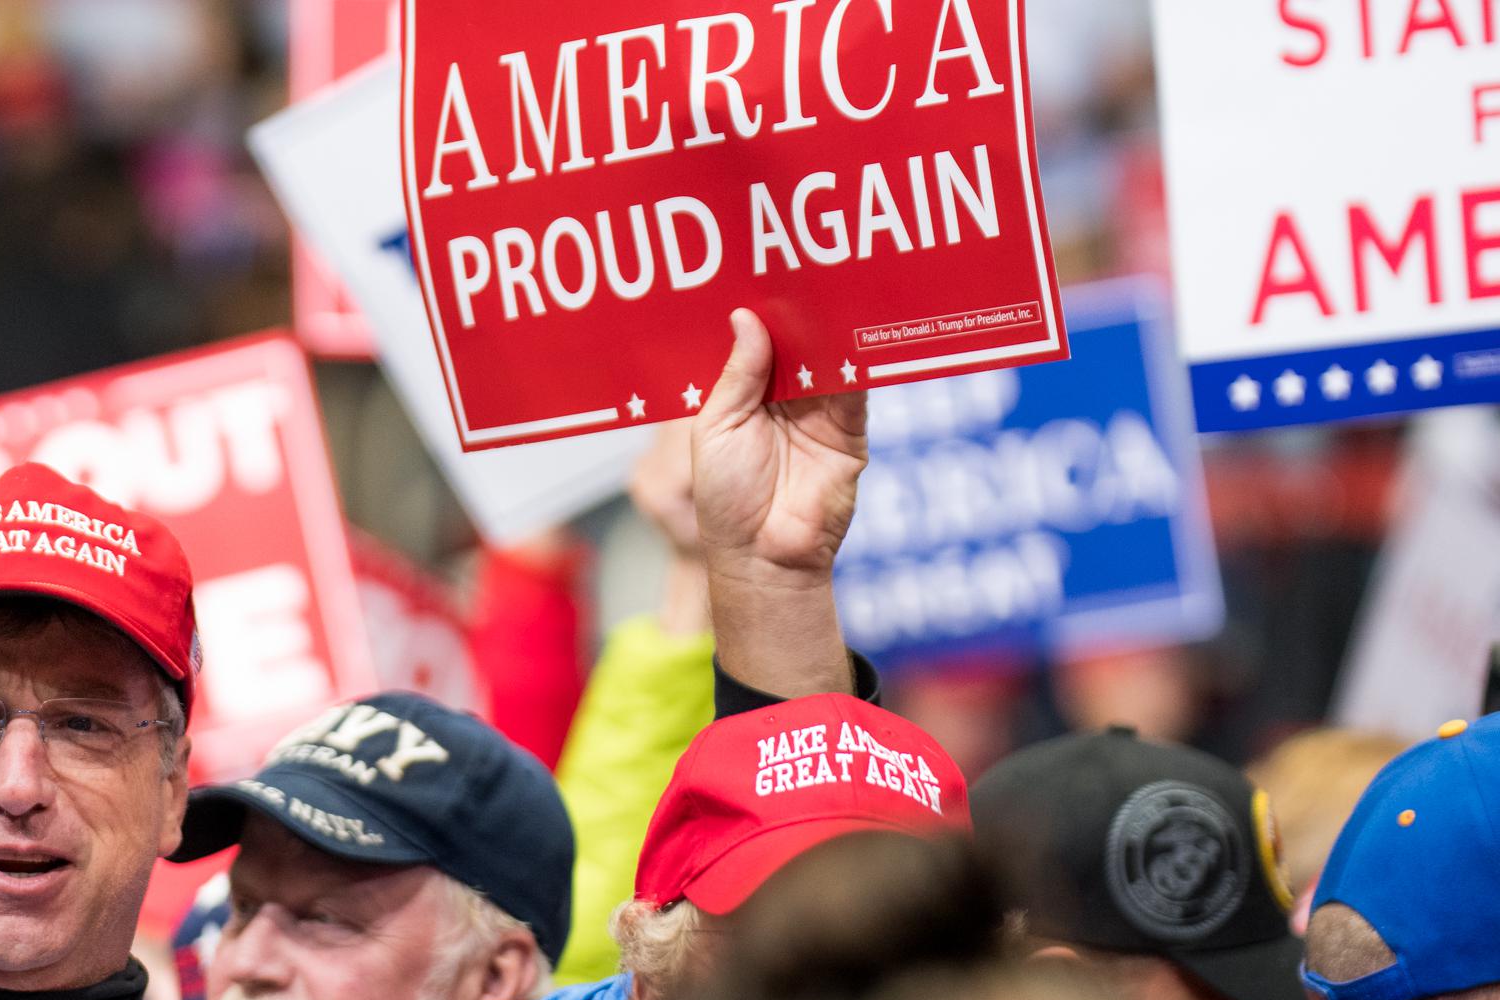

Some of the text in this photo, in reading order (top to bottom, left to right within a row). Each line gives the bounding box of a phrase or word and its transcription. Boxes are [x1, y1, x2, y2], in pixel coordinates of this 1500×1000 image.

[423, 0, 1005, 199] AMERICA
[447, 145, 1001, 329] PROUD AGAIN
[862, 331, 879, 343] Paid
[879, 329, 891, 341] for
[903, 323, 930, 338] Donald
[938, 317, 964, 332] Trump
[963, 316, 976, 328] for
[977, 309, 1018, 326] President,
[1017, 307, 1033, 320] Inc.
[5, 499, 142, 557] AMERICA
[33, 532, 127, 577] AGAIN
[755, 753, 945, 816] GREAT AGAIN
[757, 721, 940, 785] MAKE AMERICA
